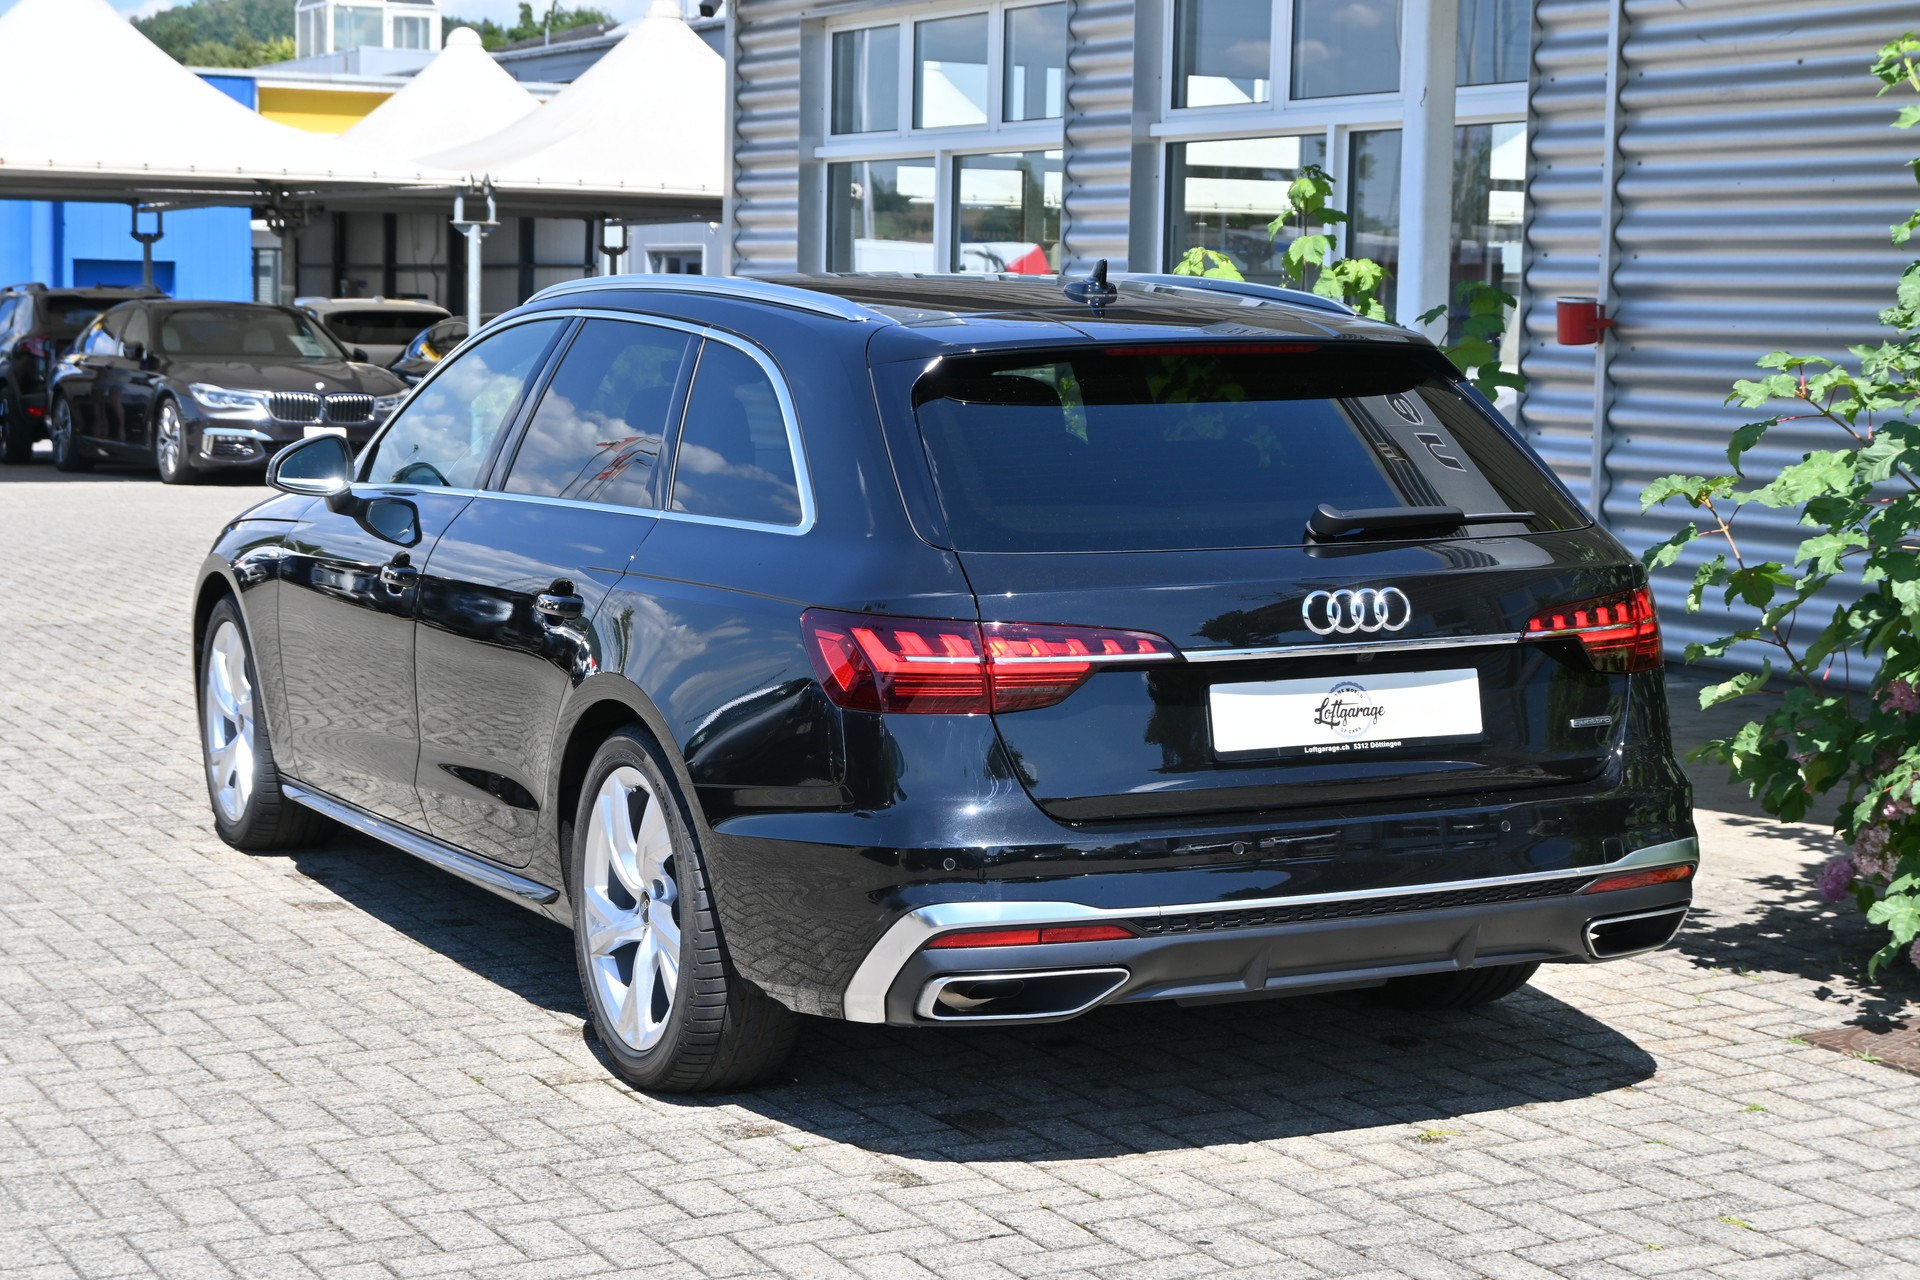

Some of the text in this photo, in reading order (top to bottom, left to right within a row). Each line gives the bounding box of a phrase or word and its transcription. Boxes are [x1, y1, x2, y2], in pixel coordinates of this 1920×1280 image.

[1314, 697, 1386, 730] Loftgarage
[1304, 740, 1402, 754] Loftgarage.ch 5312 Döttingen
